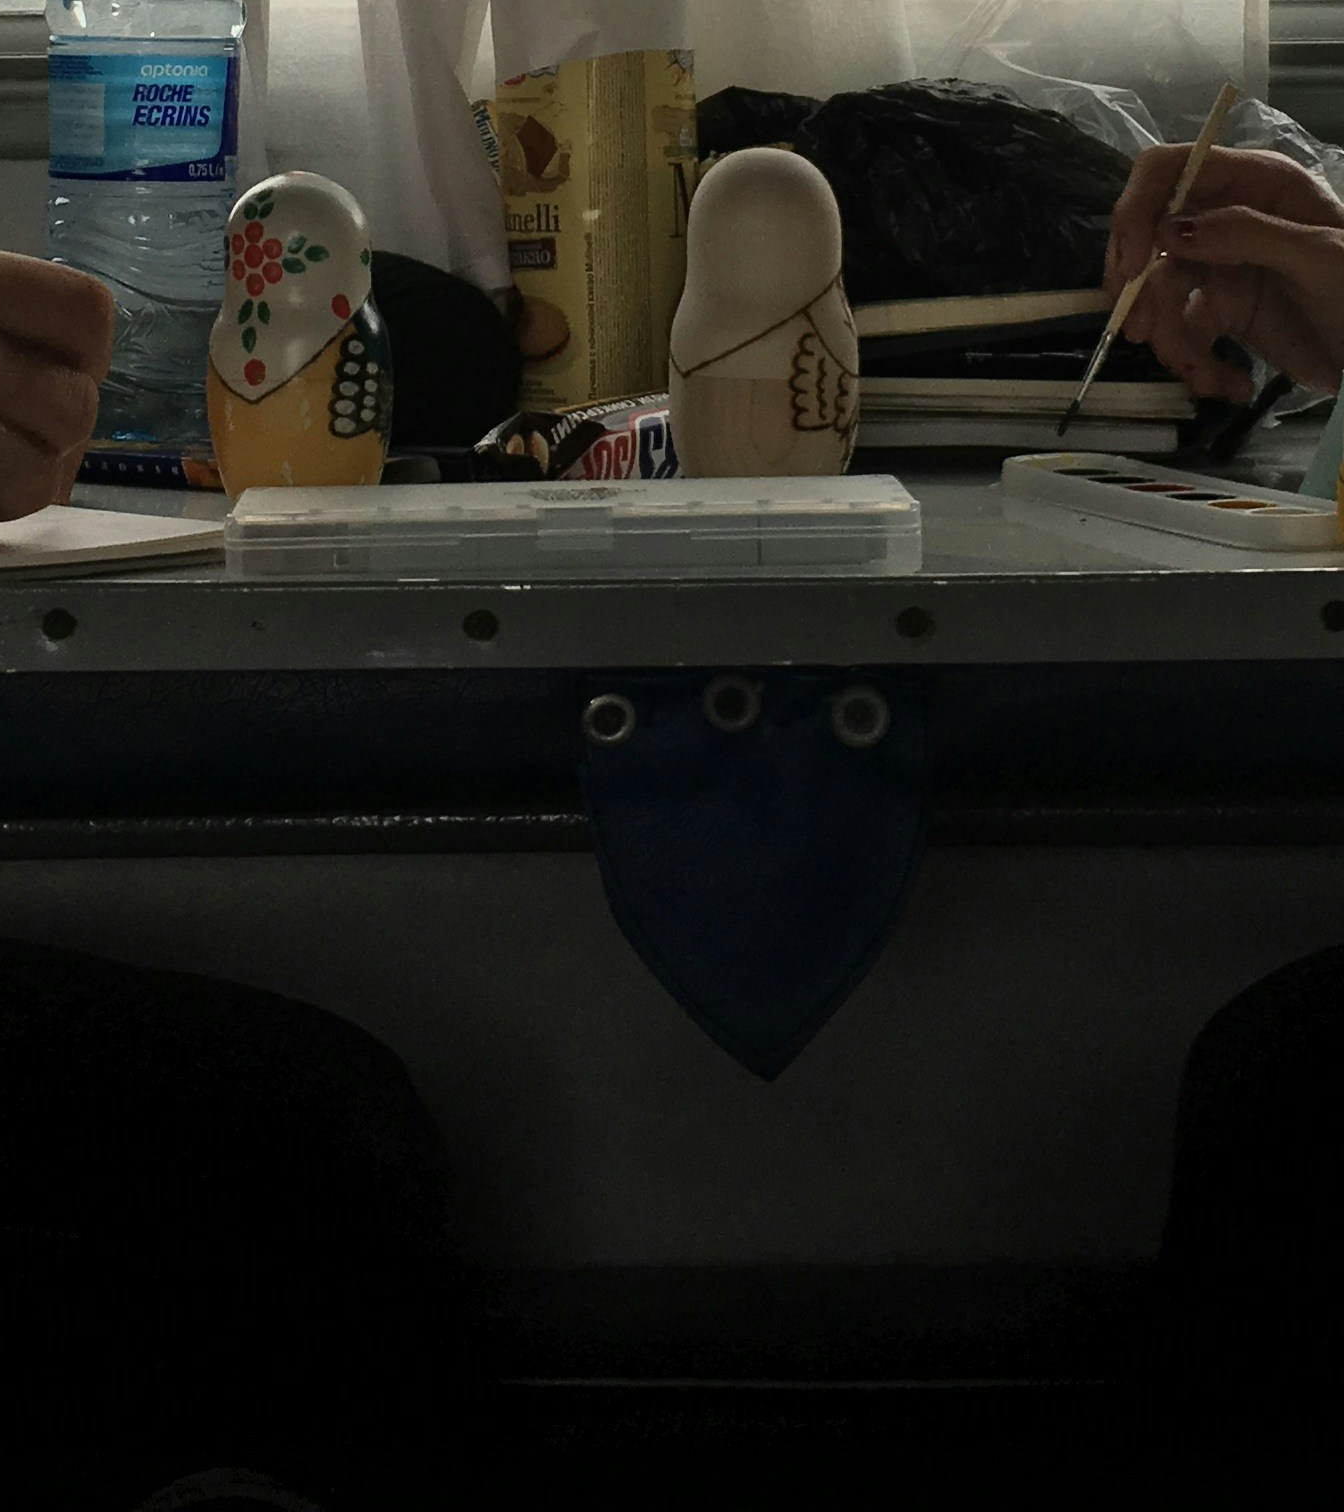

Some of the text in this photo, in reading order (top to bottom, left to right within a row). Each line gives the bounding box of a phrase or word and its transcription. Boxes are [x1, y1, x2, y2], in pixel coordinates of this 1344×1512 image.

[140, 63, 209, 79] aptonia
[132, 83, 195, 103] ROCHE
[132, 105, 212, 126] ECRINS
